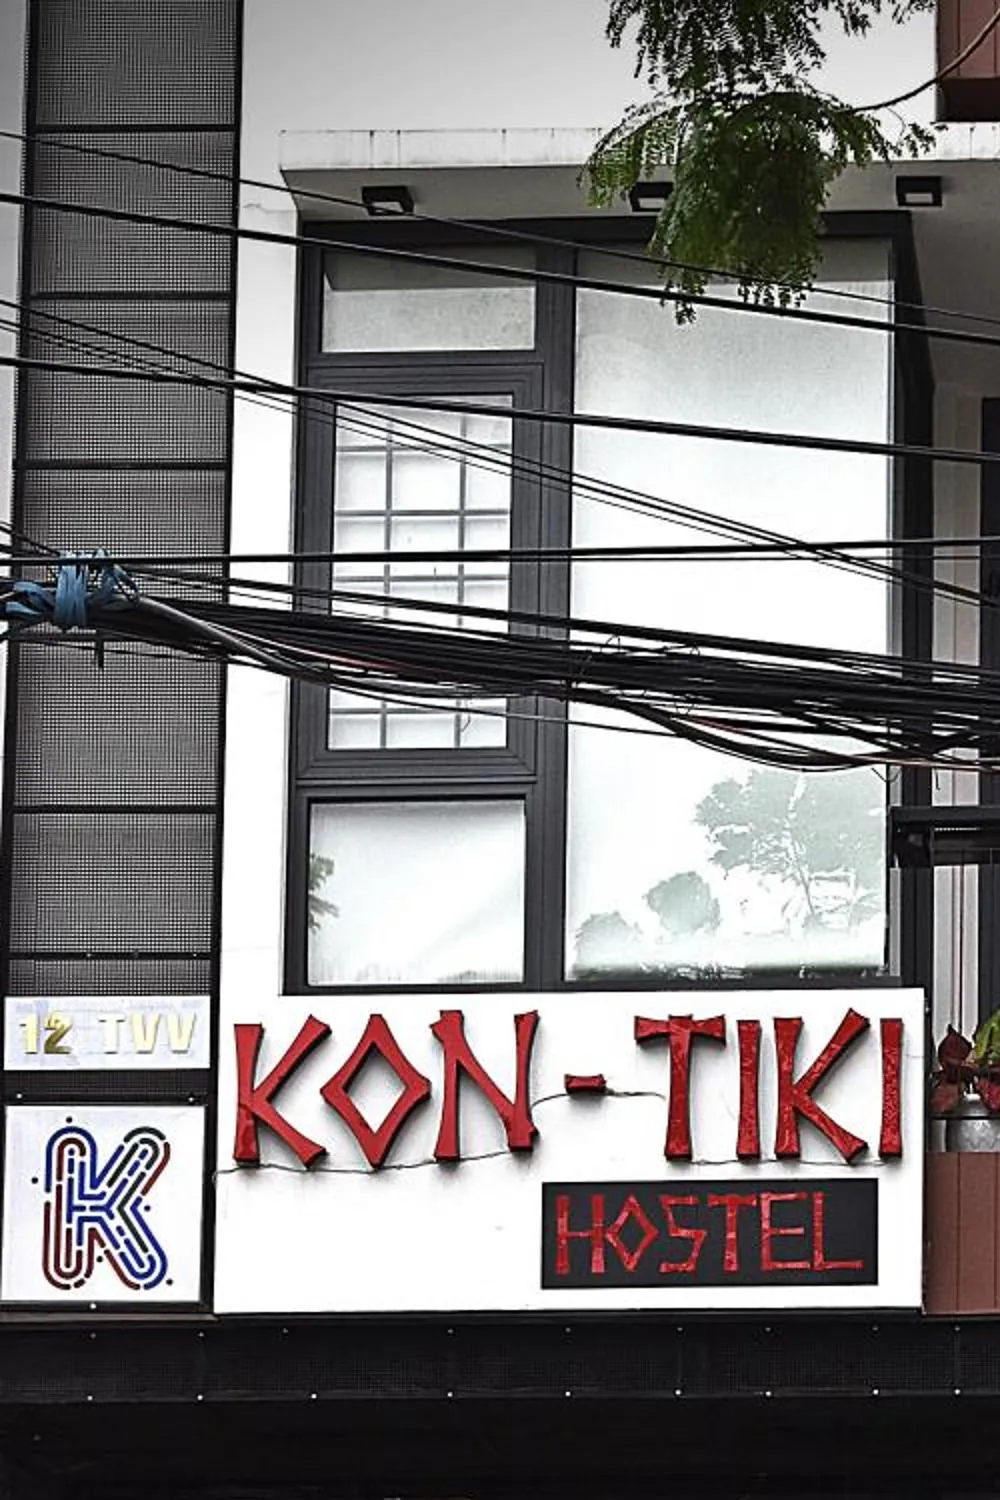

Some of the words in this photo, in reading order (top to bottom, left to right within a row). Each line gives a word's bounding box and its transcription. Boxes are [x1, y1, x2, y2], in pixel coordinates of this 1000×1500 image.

[20, 1010, 73, 1055] 12
[98, 1011, 197, 1055] TVV
[555, 1191, 864, 1275] HOSTEL
